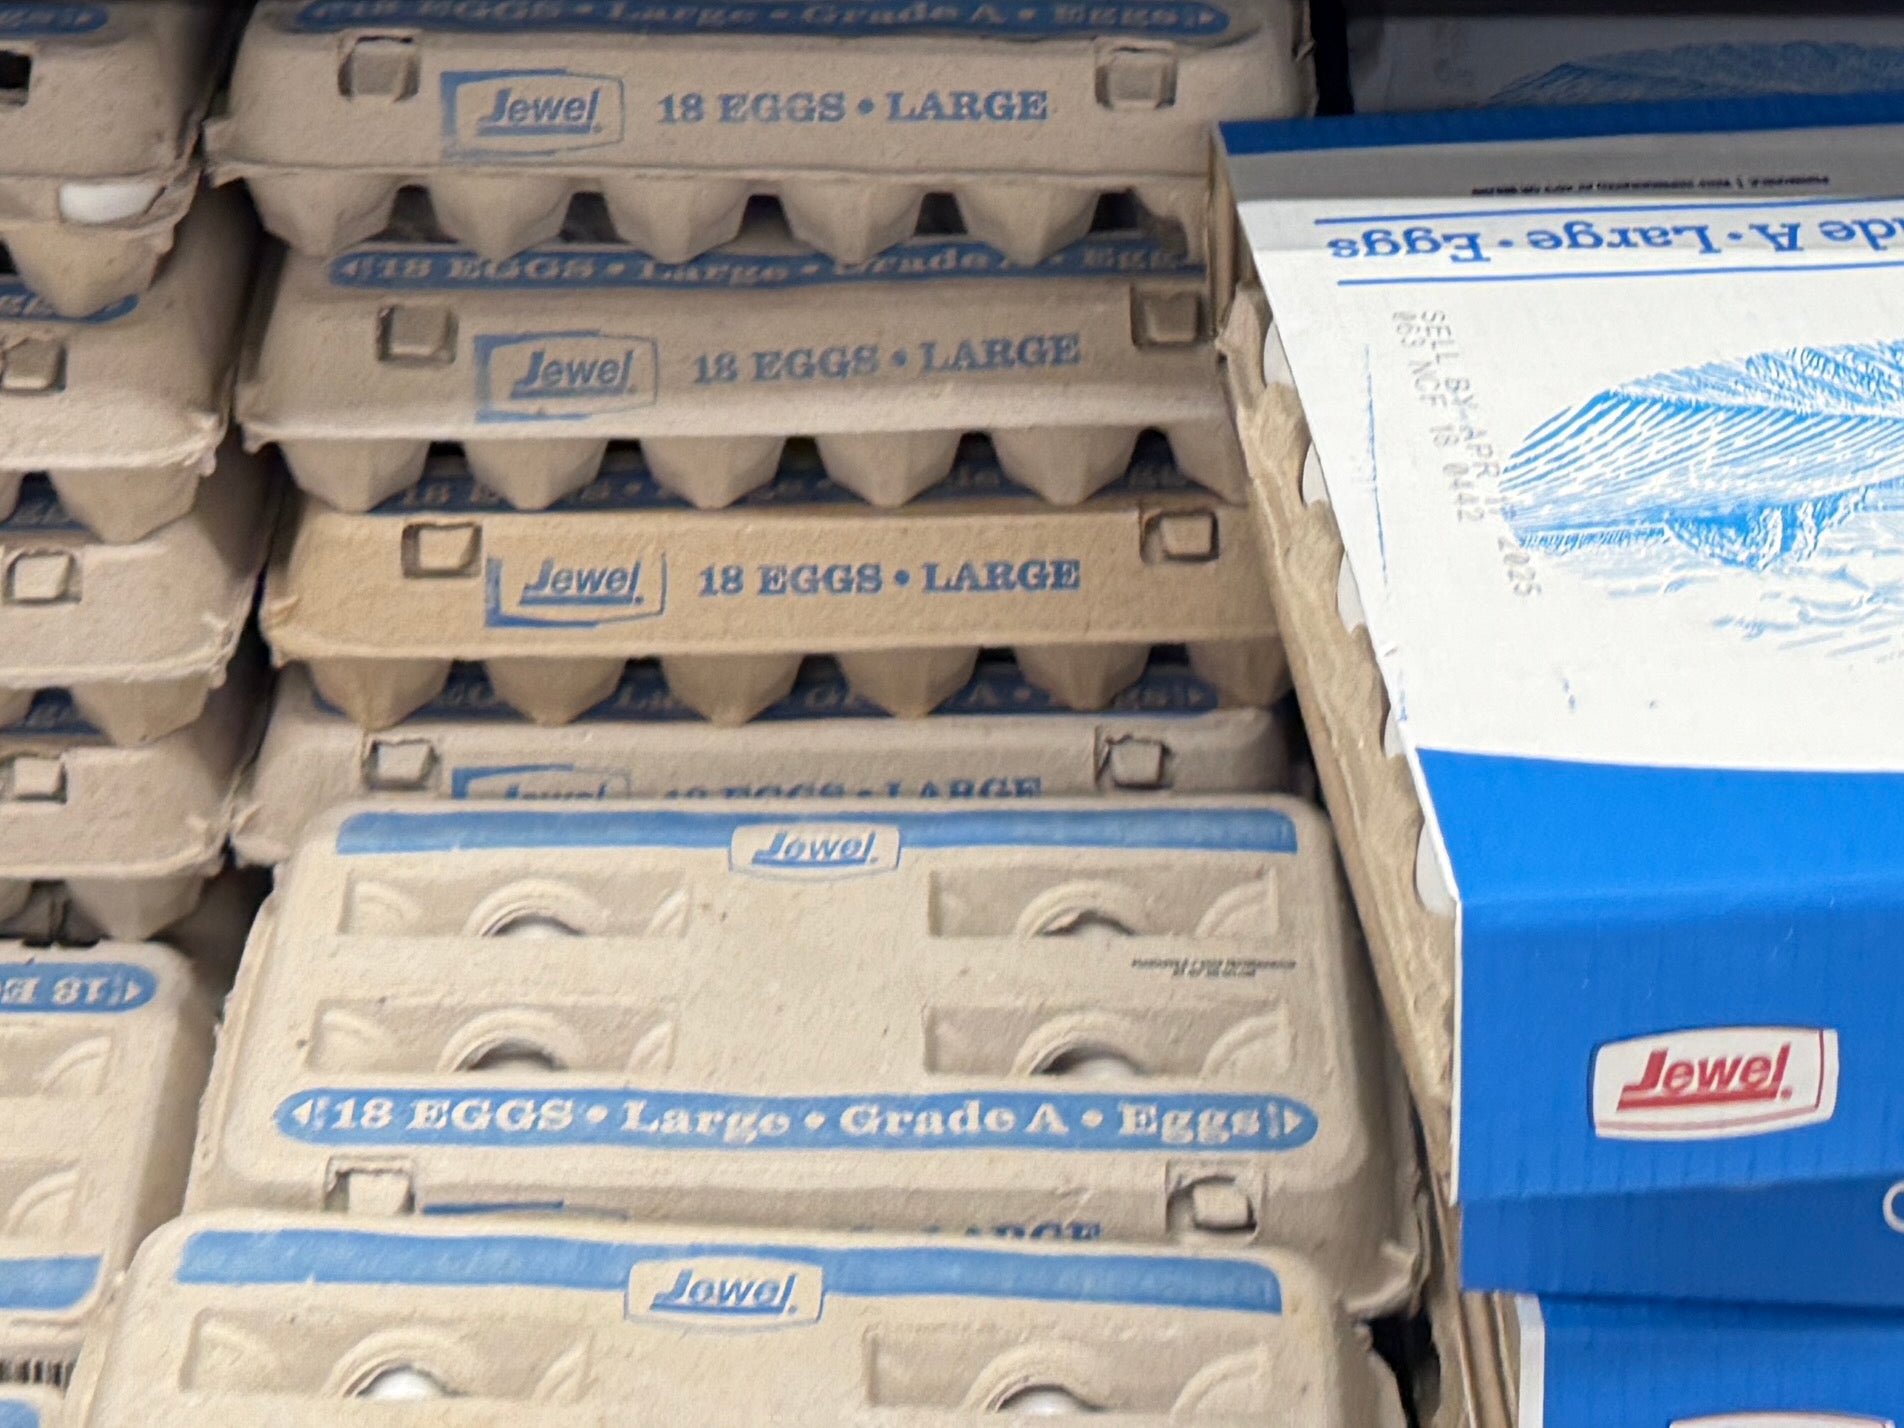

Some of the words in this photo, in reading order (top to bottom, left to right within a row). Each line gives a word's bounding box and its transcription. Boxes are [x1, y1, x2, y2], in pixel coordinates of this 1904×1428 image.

[480, 89, 600, 125] Jewel
[657, 93, 704, 124] 18
[719, 92, 845, 123] EGGS
[886, 91, 1047, 122] LARGE
[1324, 224, 1485, 268] Eggs
[1527, 216, 1719, 259] Large
[1760, 218, 1807, 251] A
[523, 558, 642, 595] Jewel
[697, 566, 744, 596] 18
[757, 563, 883, 595] EGGS
[922, 559, 1082, 592] LARGE
[753, 830, 876, 861] Jewel
[1620, 1042, 1791, 1099] Jewel
[333, 1098, 391, 1132] 18
[406, 1099, 576, 1133] EGGS
[619, 1101, 790, 1143] Large
[840, 1101, 1014, 1138] Grade
[1027, 1103, 1070, 1136] A
[1117, 1103, 1261, 1144] Eggs
